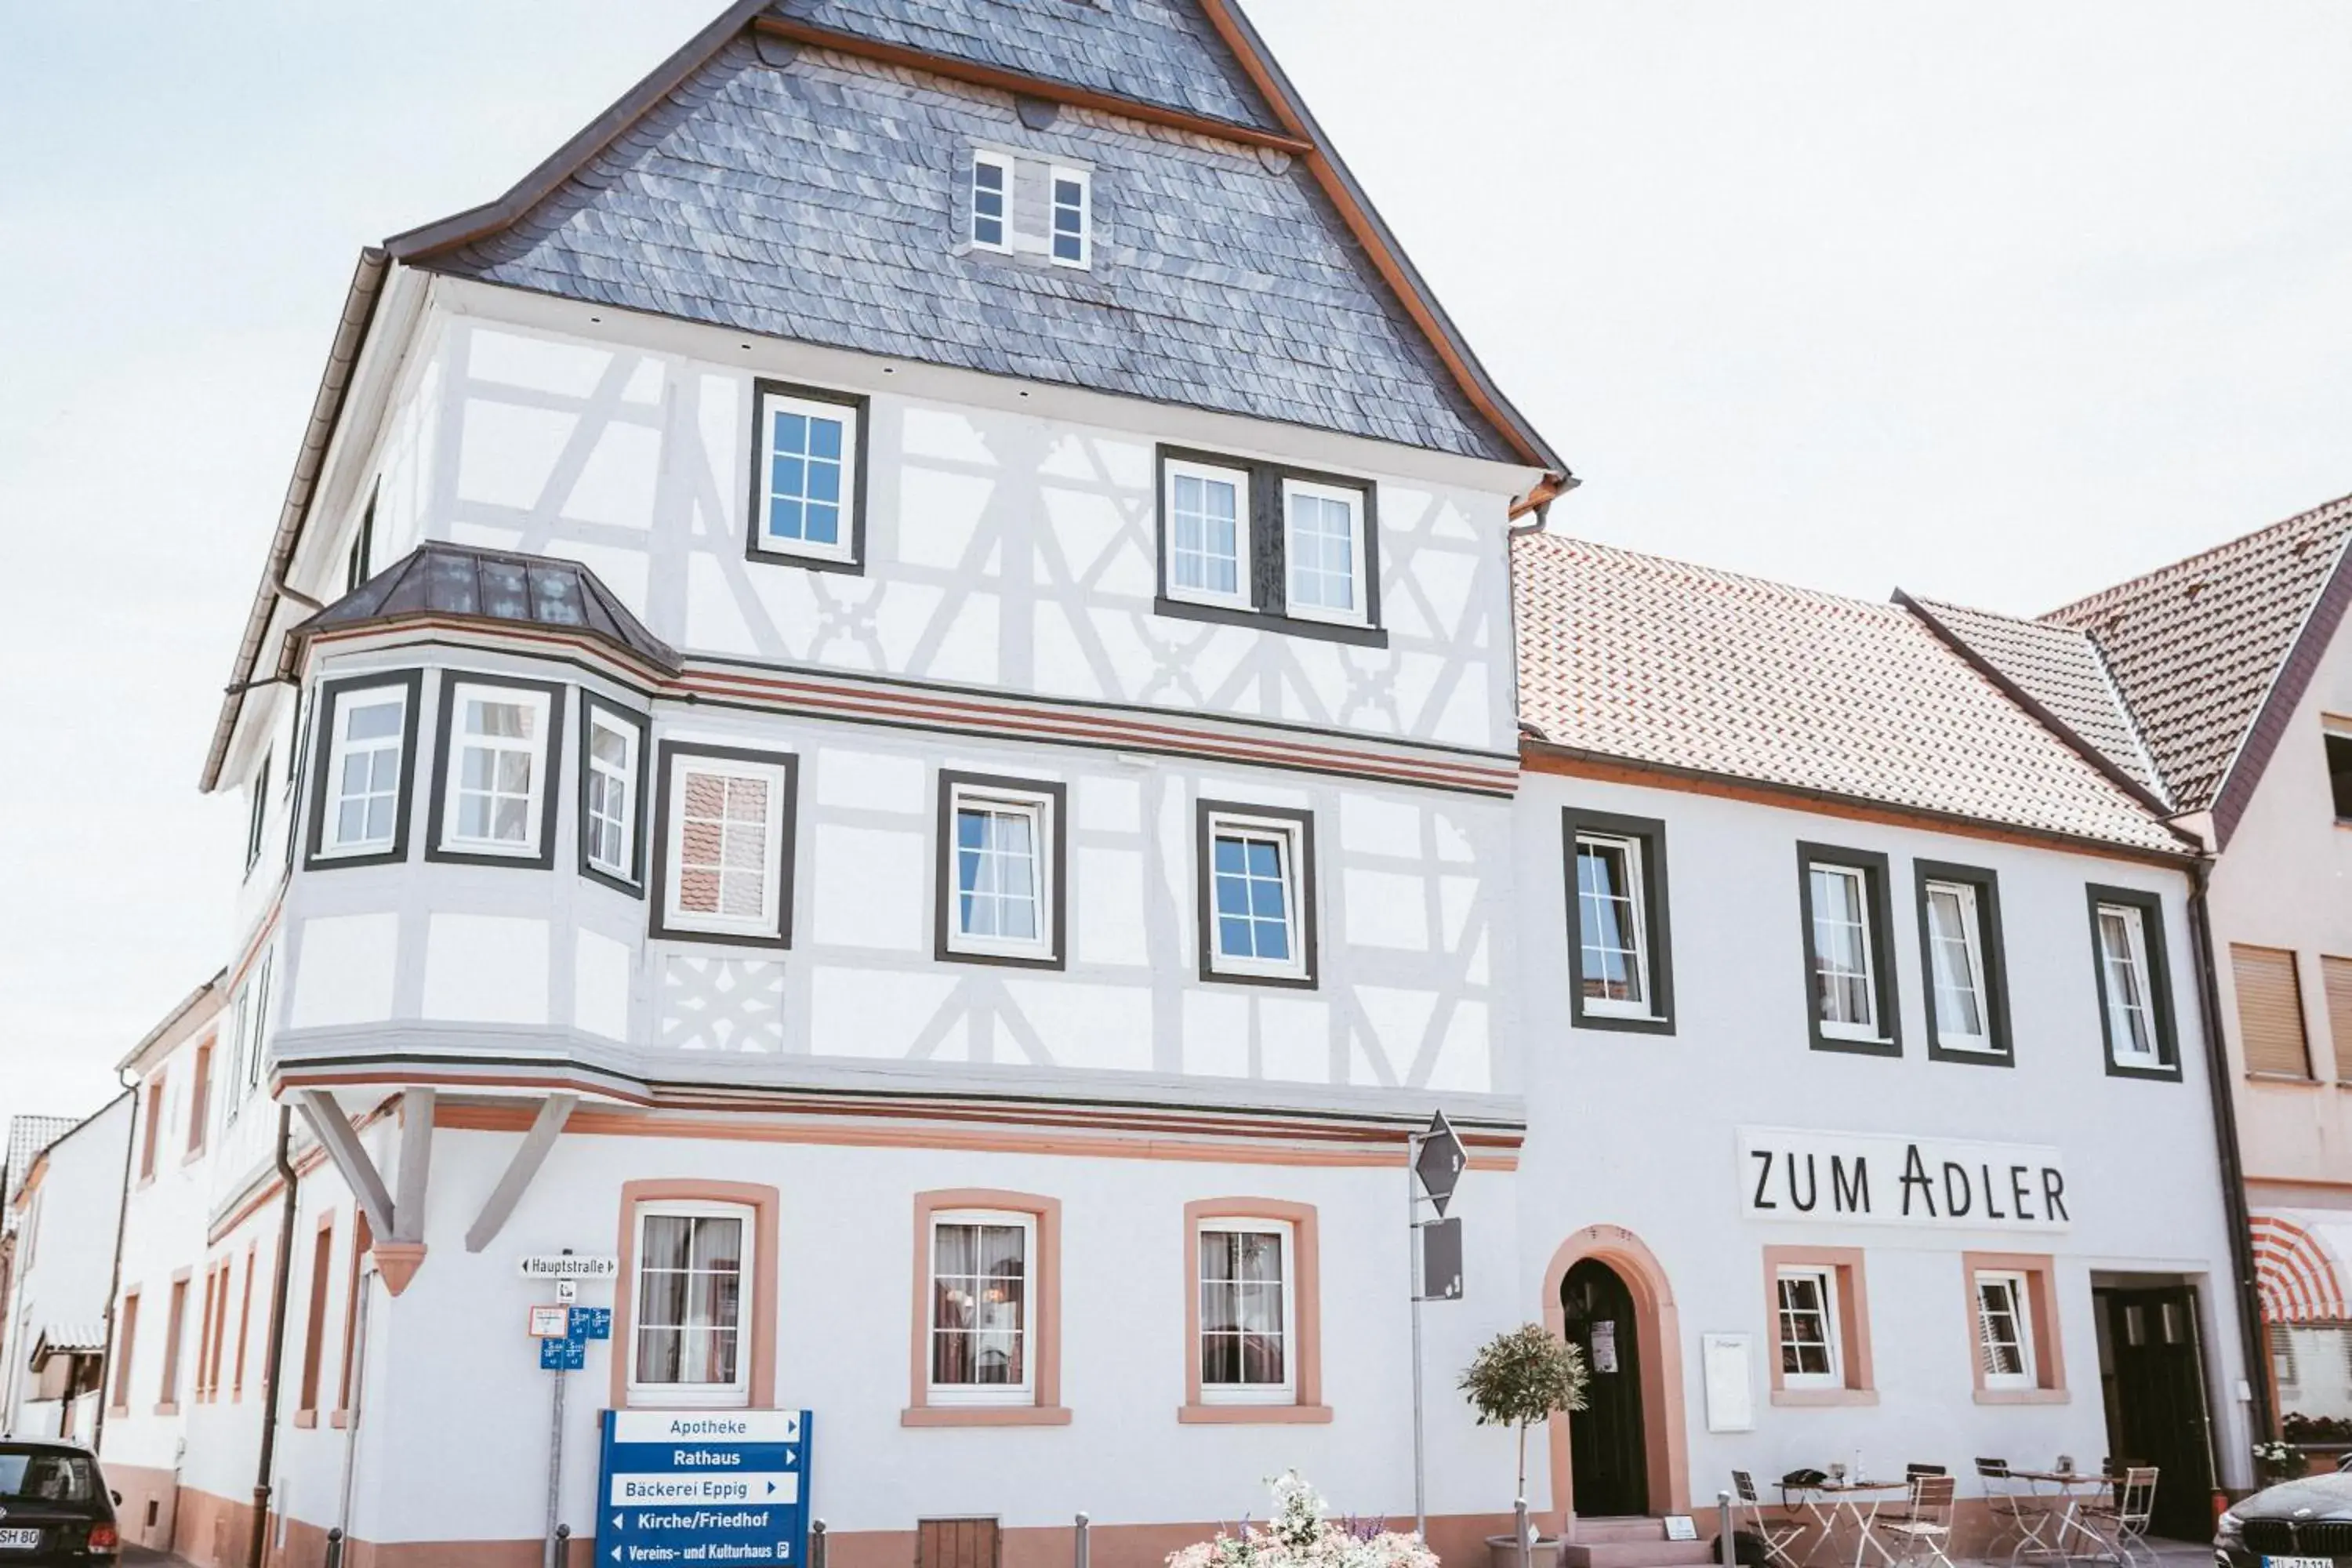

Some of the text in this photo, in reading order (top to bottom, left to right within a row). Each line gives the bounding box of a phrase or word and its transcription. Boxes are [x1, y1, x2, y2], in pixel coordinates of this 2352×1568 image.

[1751, 1144, 2070, 1221] ZUM ADLER
[532, 1258, 604, 1275] Hauptstraße
[670, 1420, 746, 1436] Apotheke
[673, 1450, 741, 1465] Rathaus
[626, 1482, 748, 1498] Bäckerei Eppig
[637, 1512, 769, 1529] Kirche/Friedhof
[628, 1545, 681, 1561] Vereins-
[684, 1545, 705, 1559] und
[708, 1543, 772, 1559] Kulturhaus
